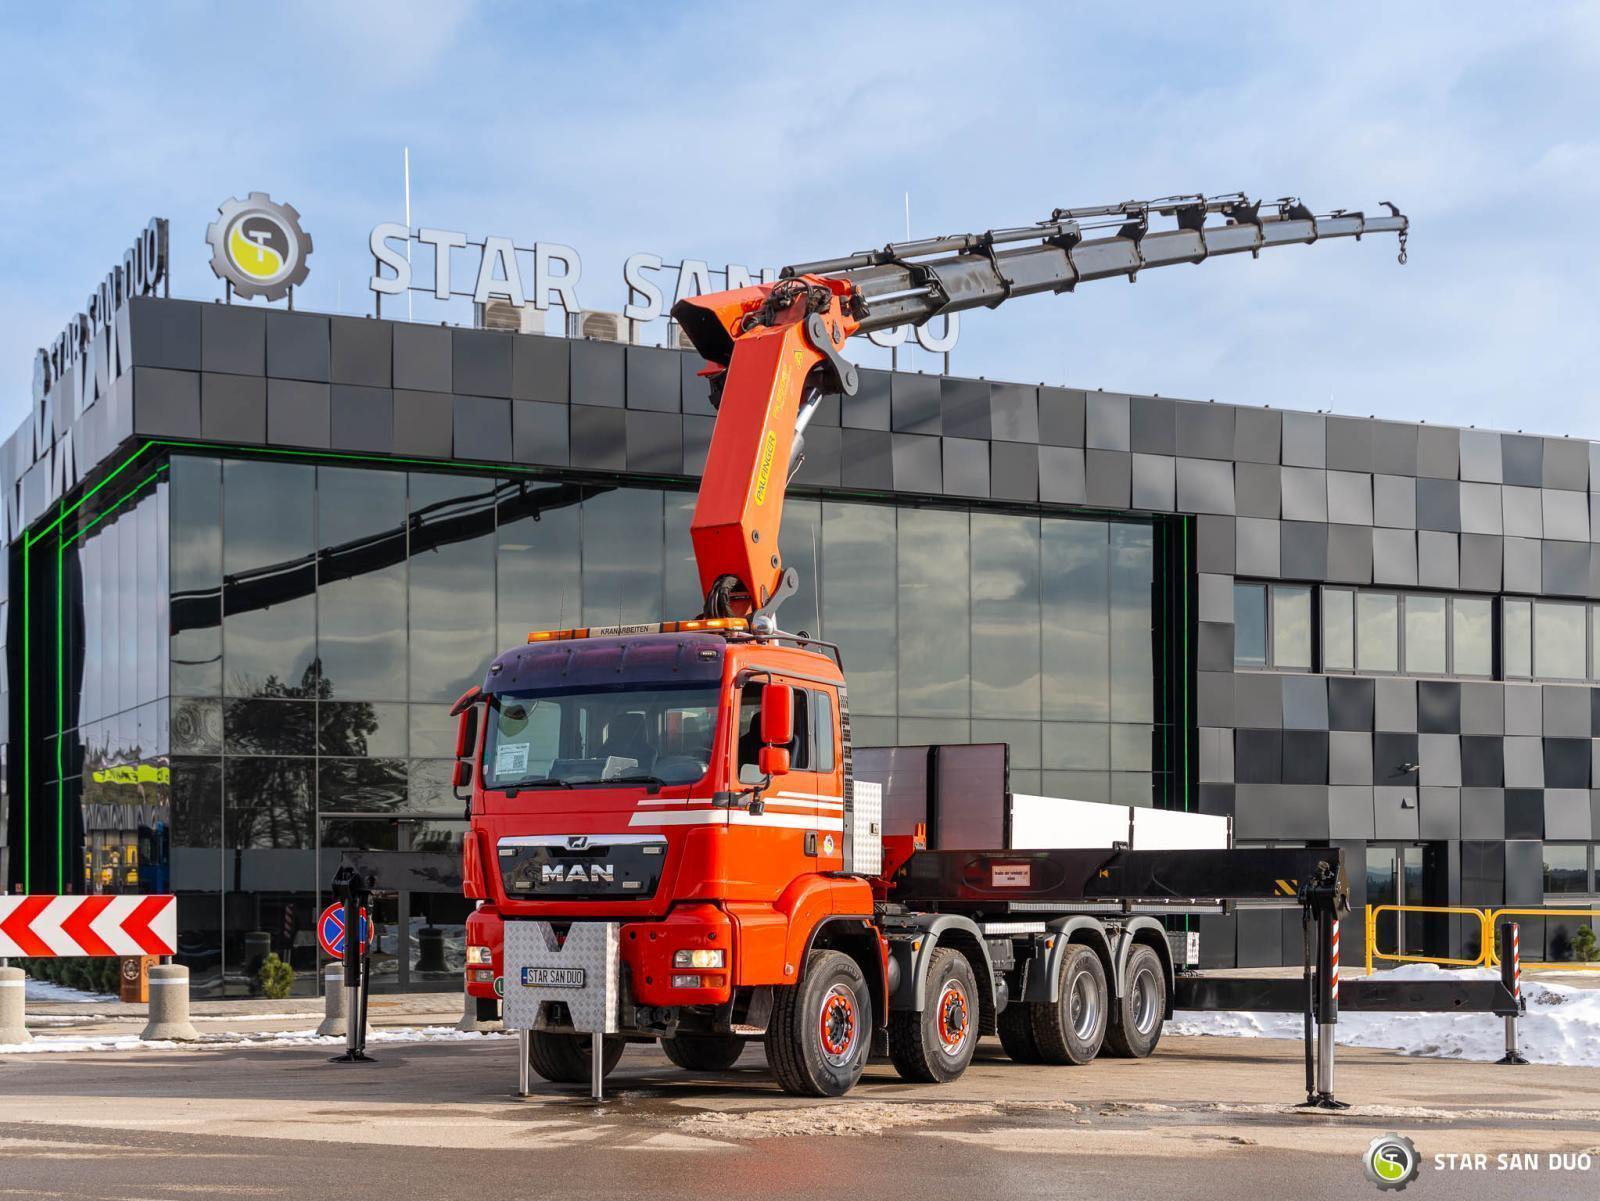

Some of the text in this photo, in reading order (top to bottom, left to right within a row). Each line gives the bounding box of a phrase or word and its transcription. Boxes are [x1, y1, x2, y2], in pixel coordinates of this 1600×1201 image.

[369, 223, 583, 314] STAR
[756, 434, 776, 502] PALFINGER
[600, 625, 649, 636] KRANARBEITEN
[542, 864, 614, 882] MAN
[528, 969, 582, 984] STAR SAN DUO
